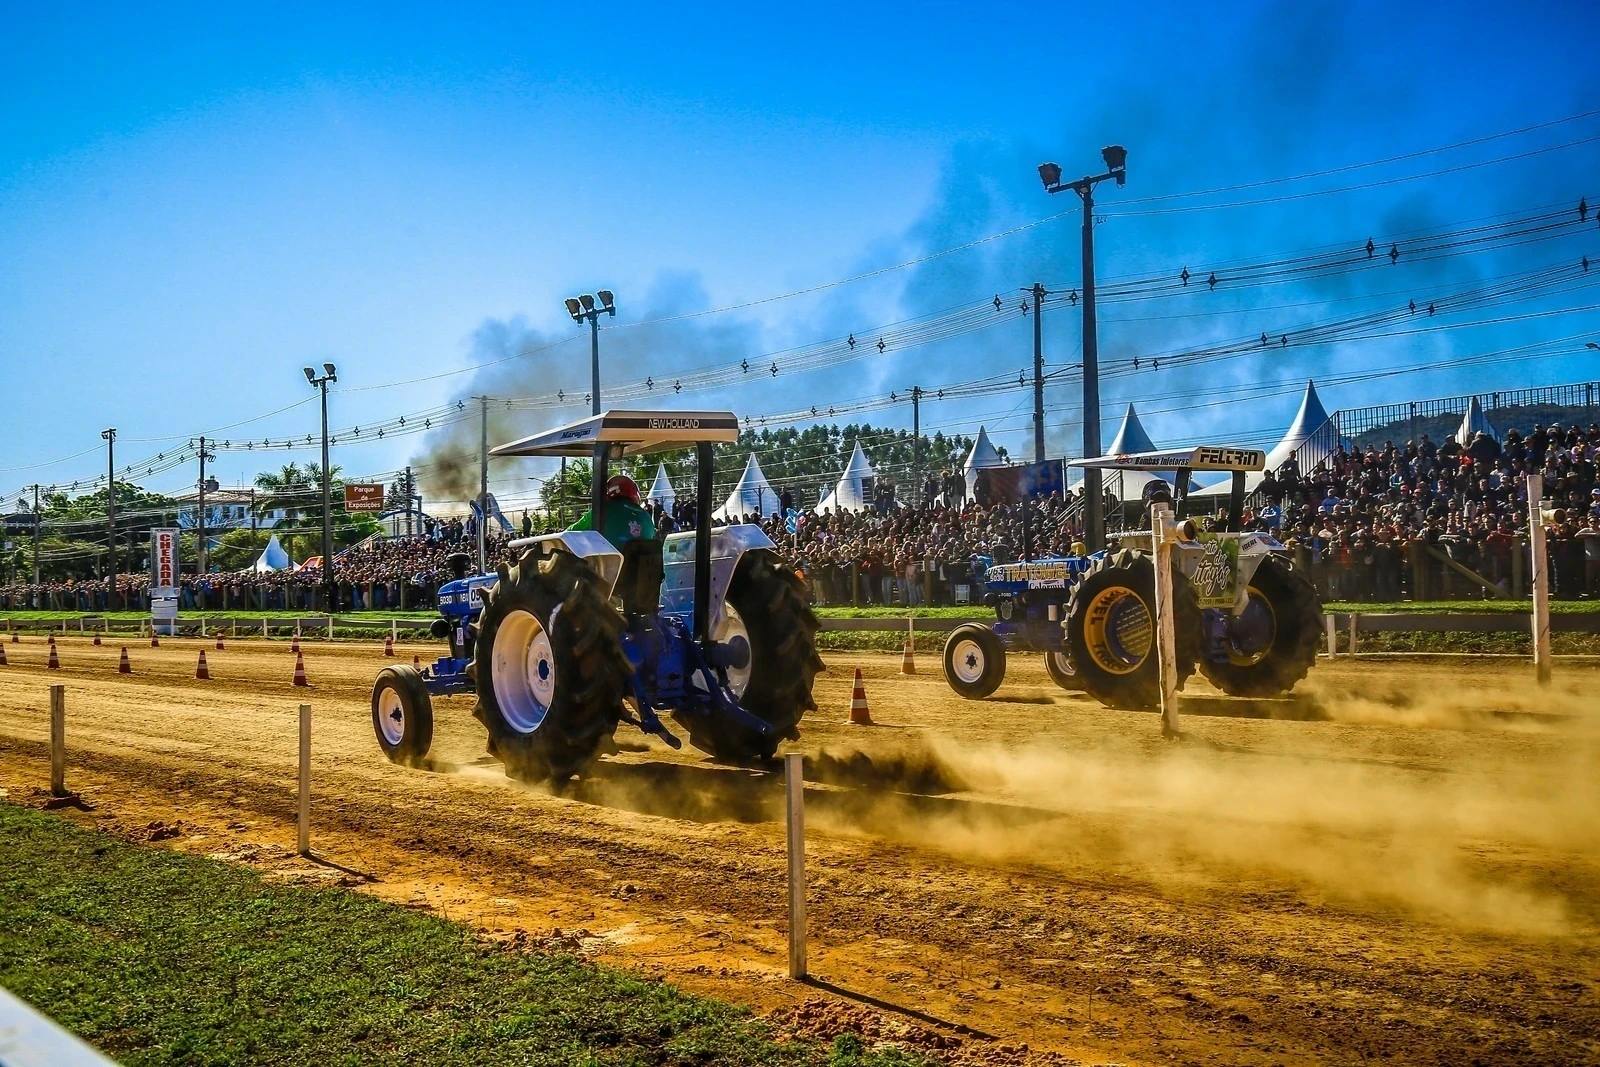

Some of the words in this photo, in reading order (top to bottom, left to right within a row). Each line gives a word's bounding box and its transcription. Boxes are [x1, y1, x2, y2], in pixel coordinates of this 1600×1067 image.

[649, 419, 665, 429] NEW
[667, 419, 700, 429] HOLLAND
[1135, 457, 1160, 466] Bombas
[1161, 456, 1189, 466] Injetoras
[1242, 539, 1257, 551] IDEAL
[160, 534, 171, 587] CHEGADA
[440, 596, 453, 604] 5030
